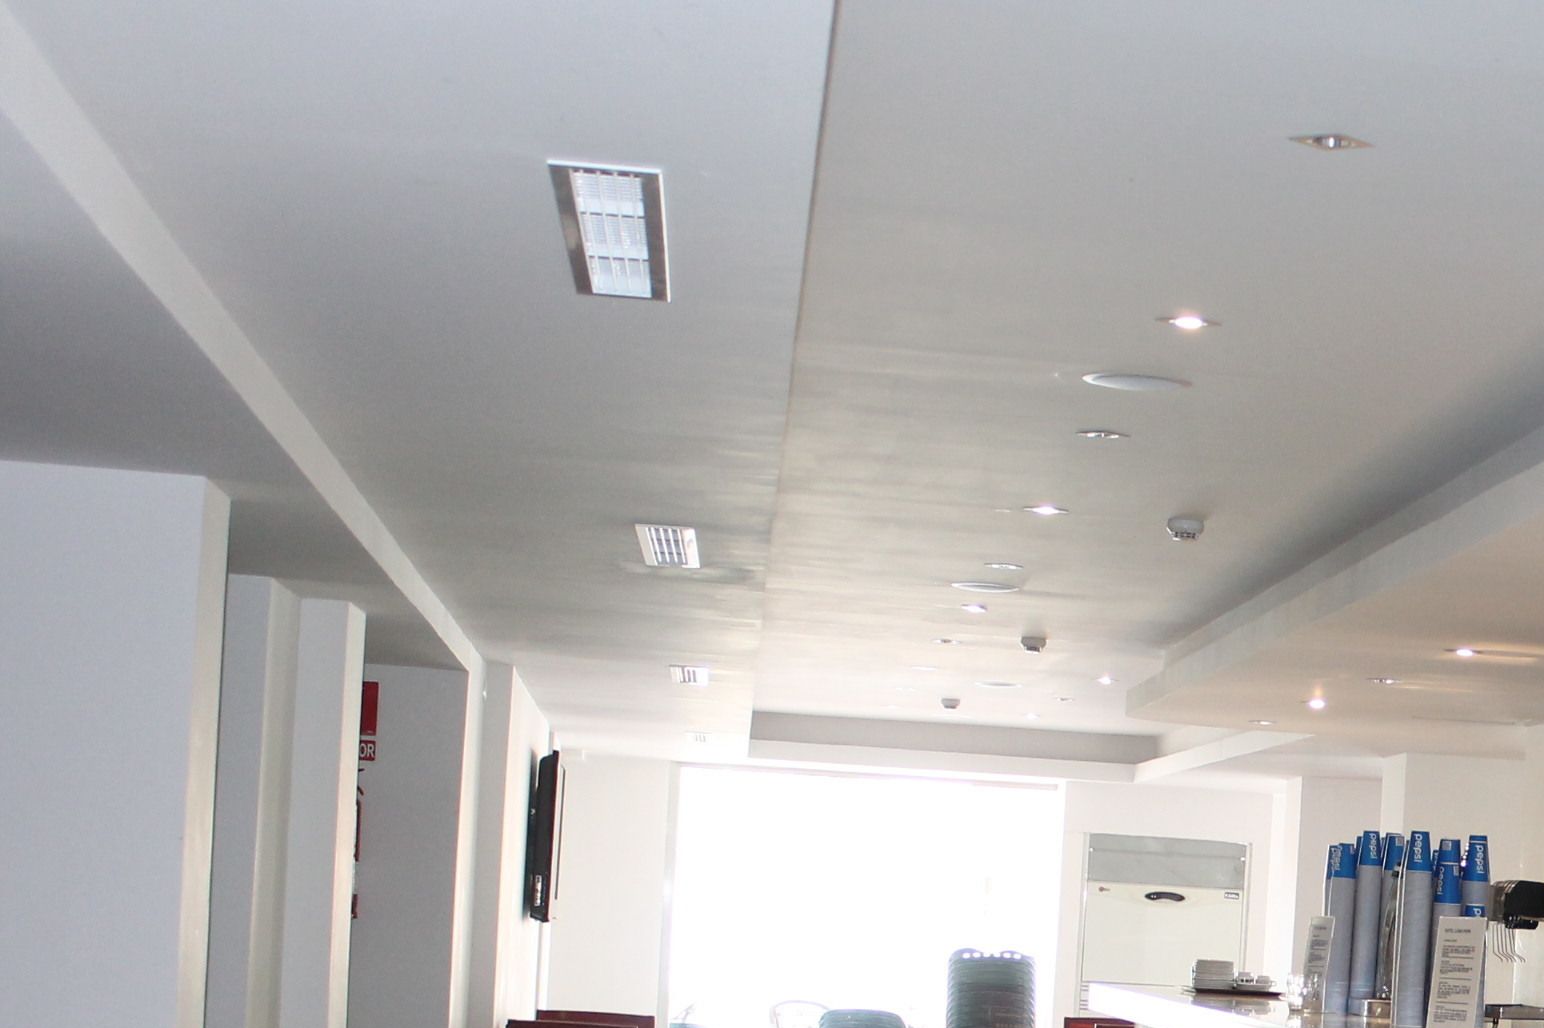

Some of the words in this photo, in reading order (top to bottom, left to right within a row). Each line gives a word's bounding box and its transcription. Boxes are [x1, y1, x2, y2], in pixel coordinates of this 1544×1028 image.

[1368, 833, 1378, 860] pepsi
[1413, 833, 1423, 863] pepsi
[1474, 845, 1485, 874] pepsi
